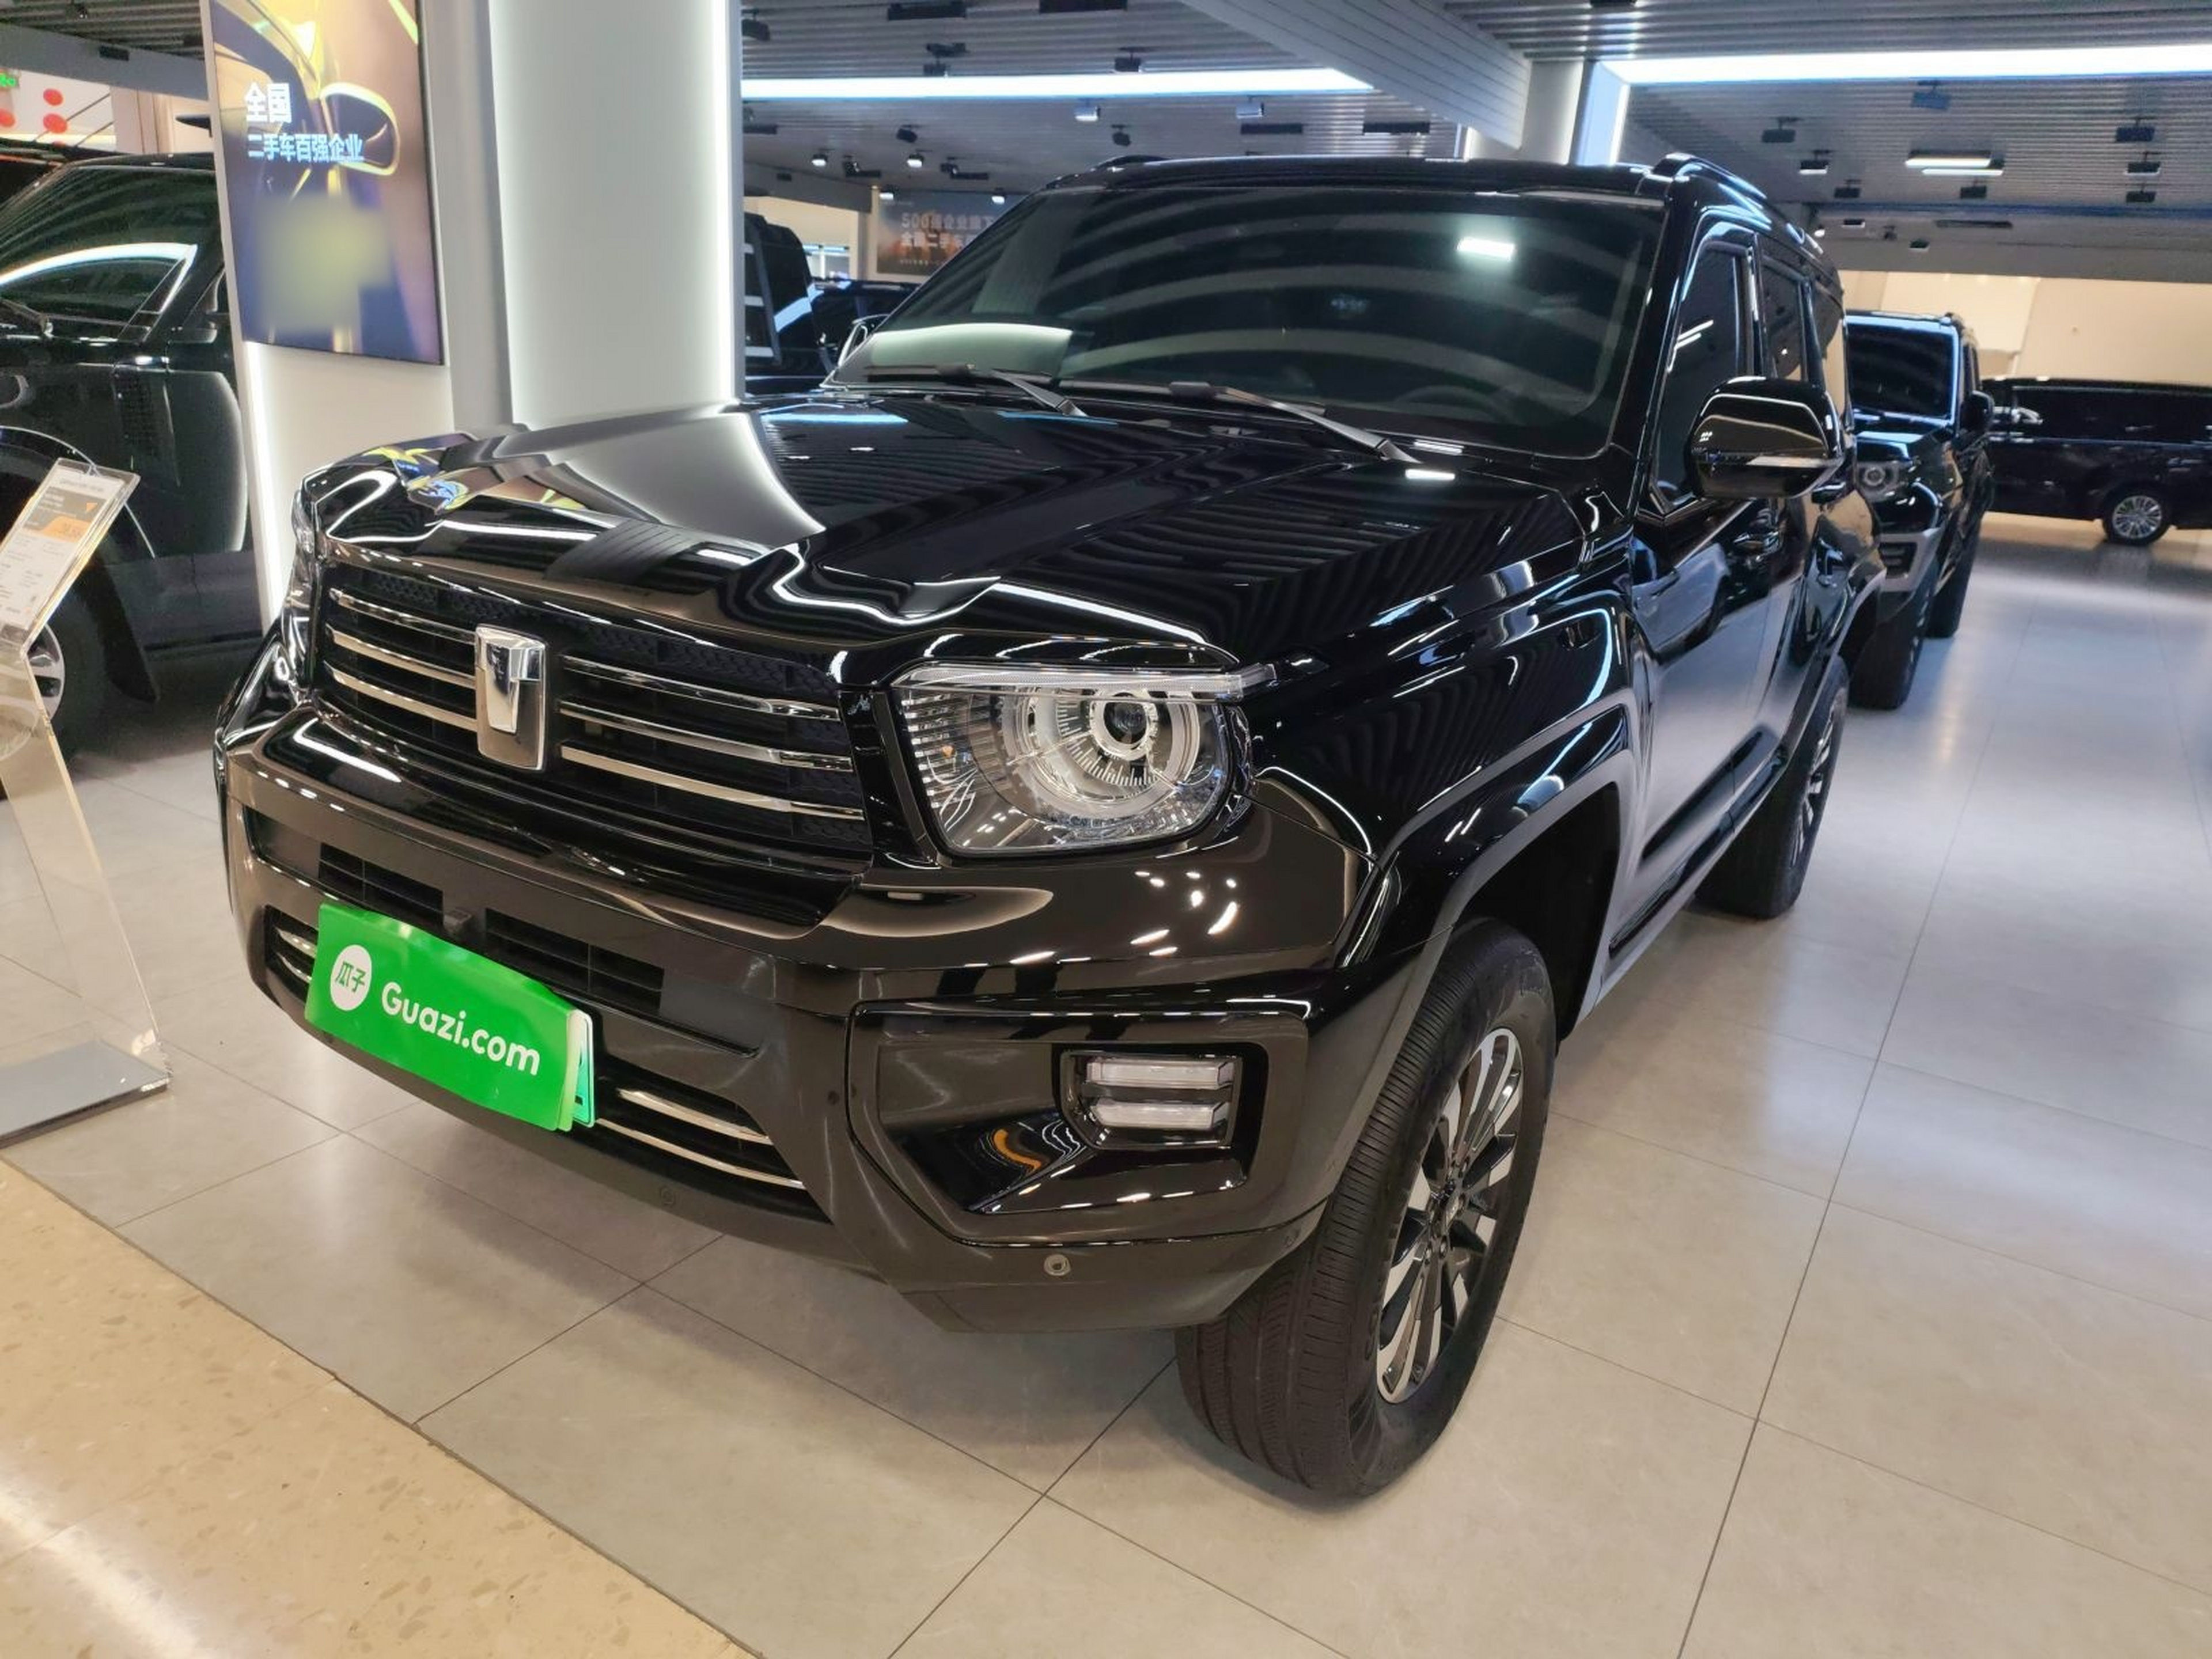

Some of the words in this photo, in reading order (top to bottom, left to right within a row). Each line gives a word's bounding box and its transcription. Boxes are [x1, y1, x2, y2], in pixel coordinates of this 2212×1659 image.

[245, 81, 292, 123] 全国
[248, 132, 365, 163] 二手车百强企业
[335, 960, 366, 993] 瓜子
[381, 982, 540, 1076] Guazi.com
